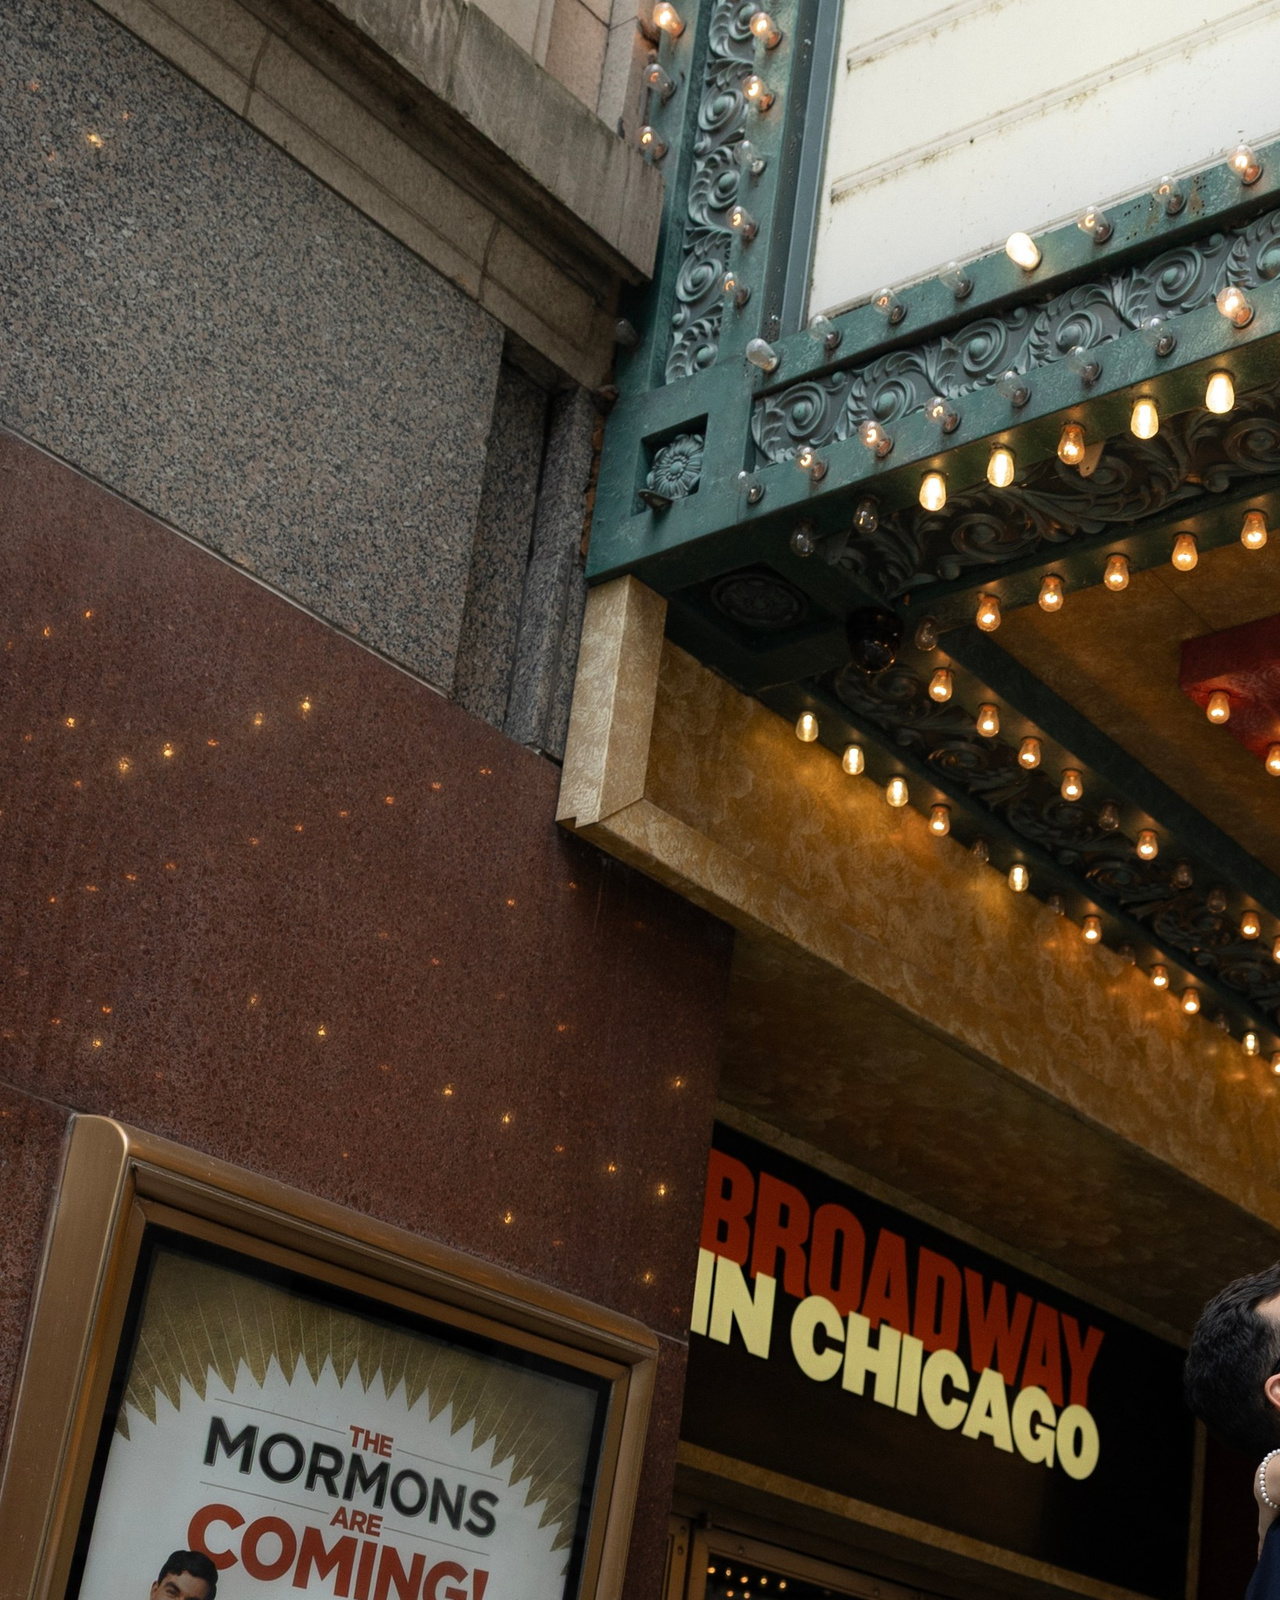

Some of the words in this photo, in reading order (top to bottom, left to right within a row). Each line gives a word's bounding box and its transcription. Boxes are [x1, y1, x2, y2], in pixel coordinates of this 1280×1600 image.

[700, 1148, 1105, 1408] BROADWAY
[690, 1247, 776, 1359] IN
[790, 1295, 1100, 1480] CHICAGO
[203, 1416, 500, 1538] MORMONS
[350, 1425, 394, 1458] THE
[329, 1506, 384, 1538] ARE
